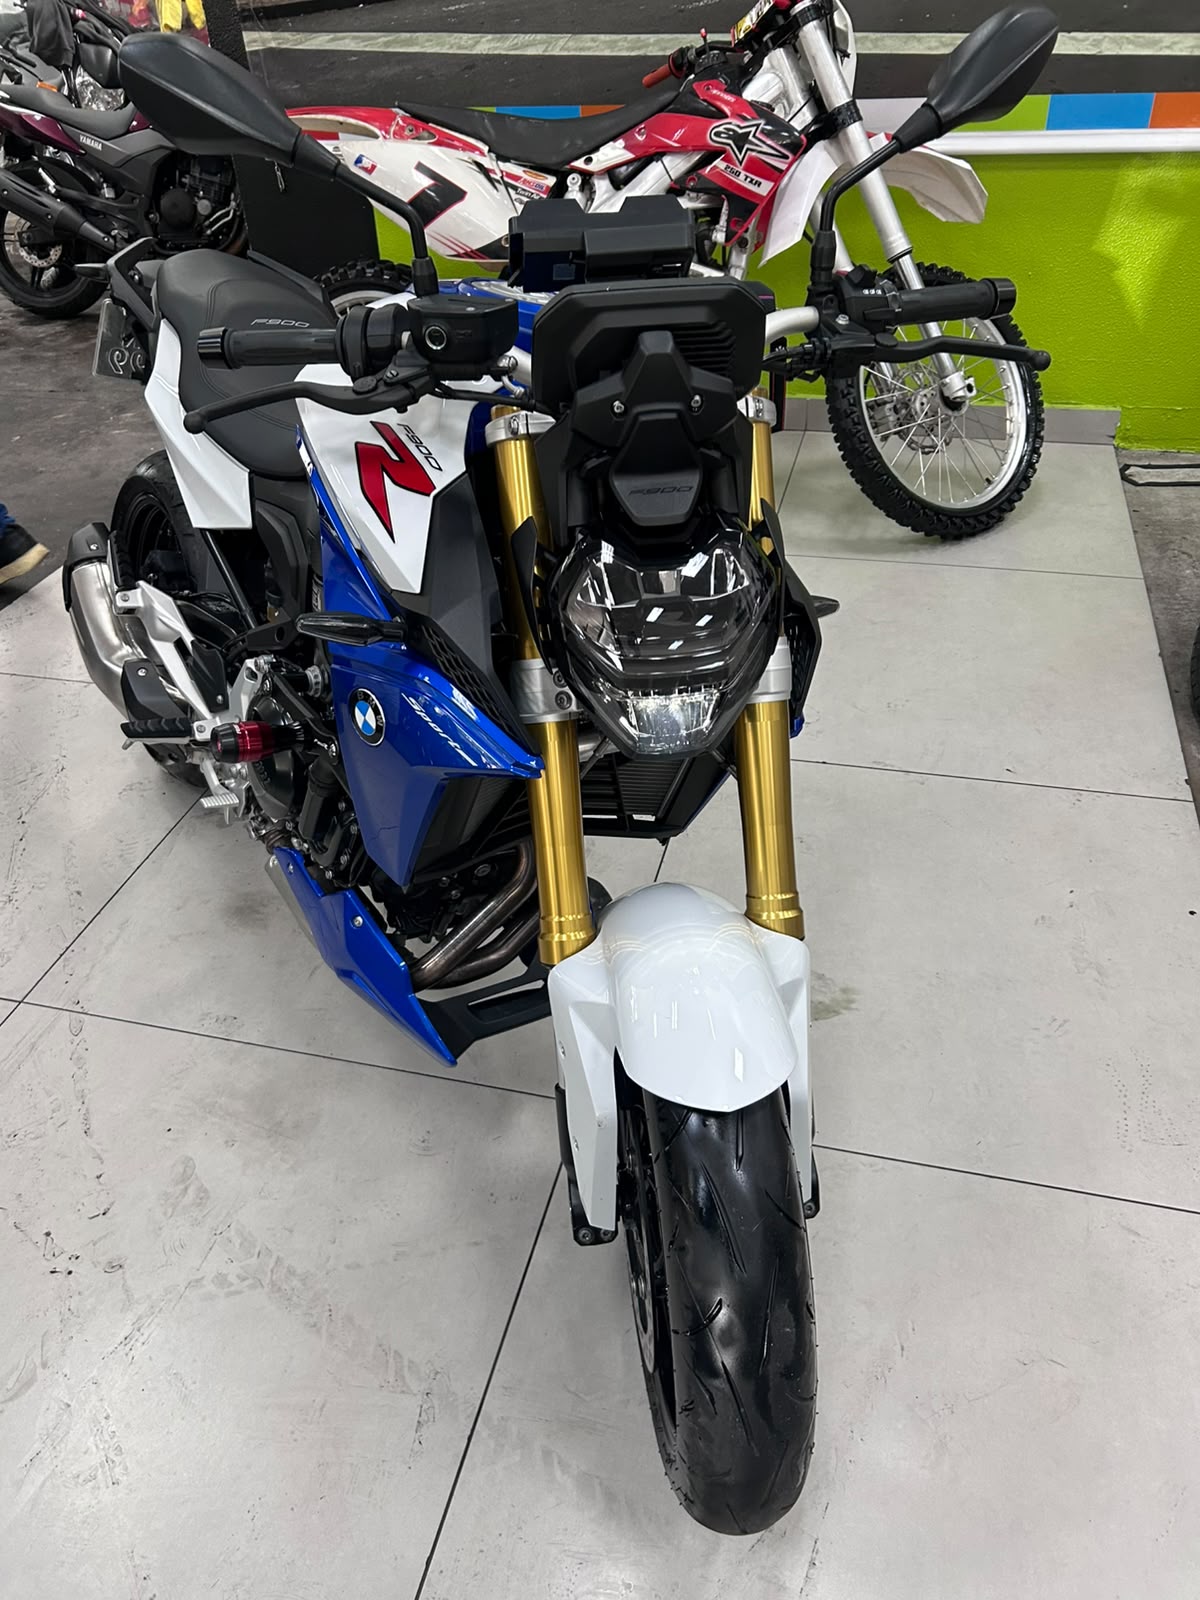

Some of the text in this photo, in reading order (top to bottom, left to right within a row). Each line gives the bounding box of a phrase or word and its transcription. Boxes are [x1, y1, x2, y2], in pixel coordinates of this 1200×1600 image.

[80, 134, 102, 151] YAMAHA
[251, 319, 310, 328] F900
[397, 423, 443, 471] F900
[355, 420, 437, 544] R
[628, 486, 694, 496] F900
[401, 693, 478, 767] Sport
